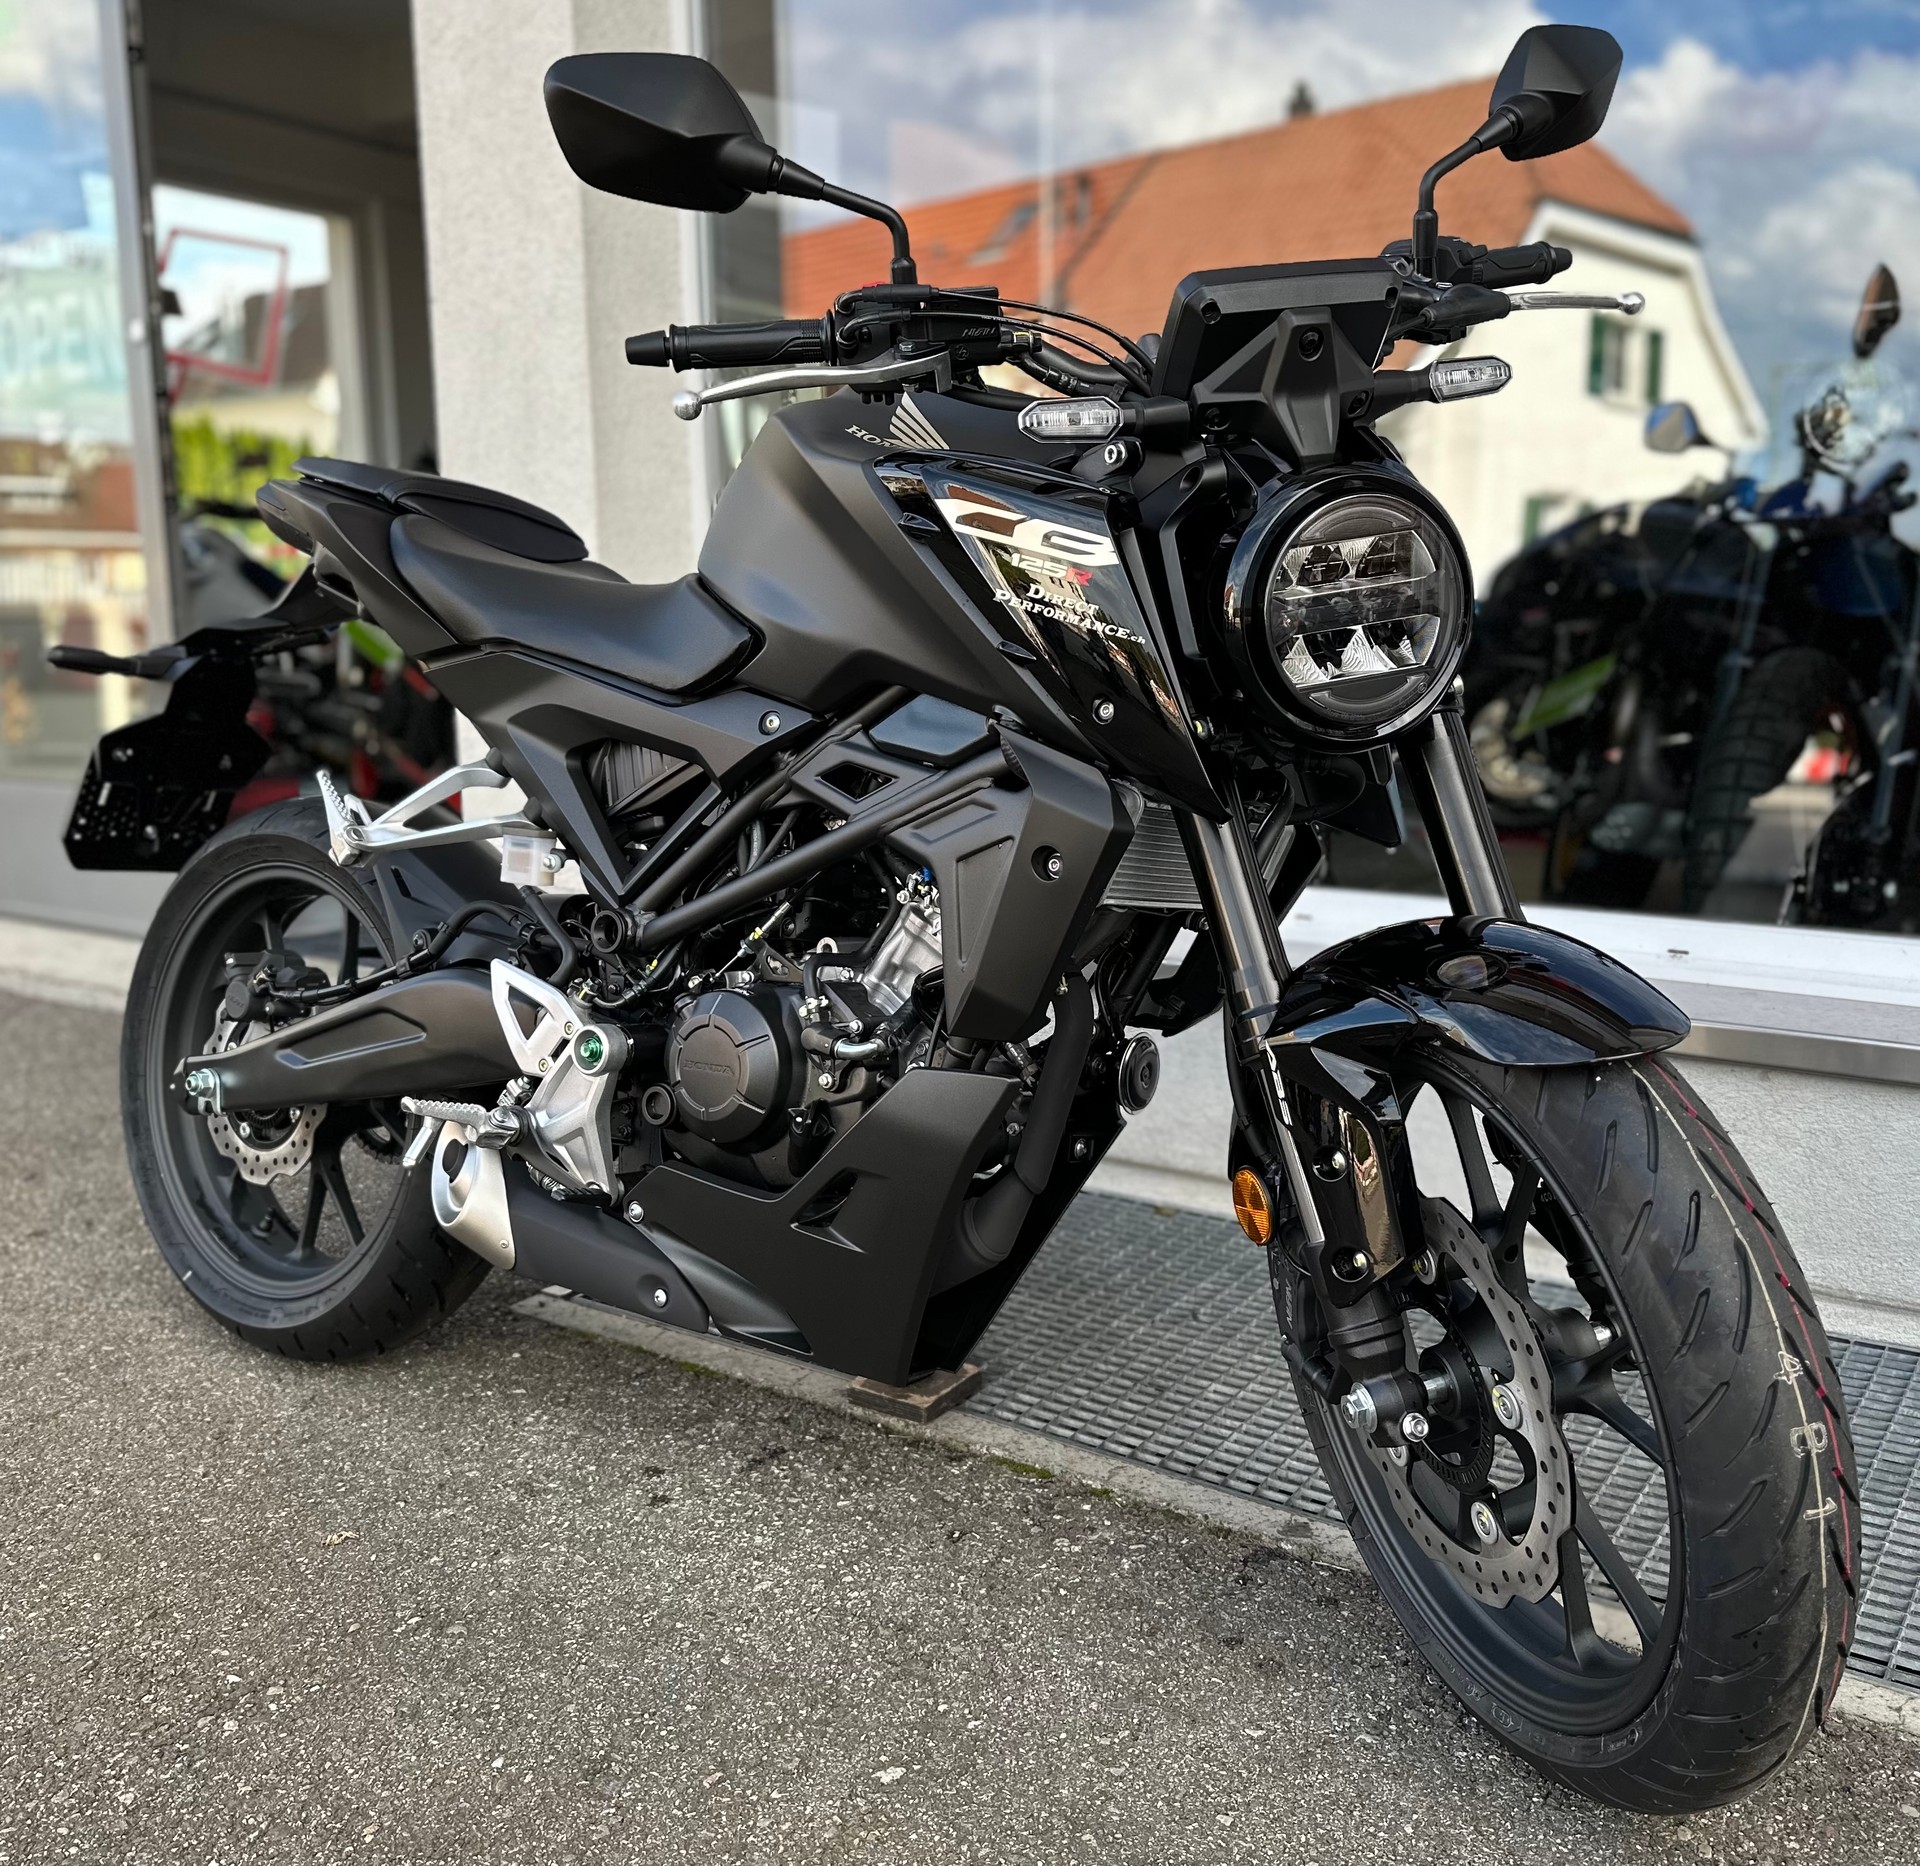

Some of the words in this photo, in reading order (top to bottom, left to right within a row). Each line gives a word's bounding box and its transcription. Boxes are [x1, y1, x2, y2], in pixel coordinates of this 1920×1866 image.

[844, 424, 897, 448] HON
[935, 498, 1120, 567] CB
[1010, 551, 1094, 588] 125R
[1025, 582, 1099, 616] DIRECT
[682, 1059, 736, 1076] HONDA
[1264, 1039, 1294, 1127] ABS
